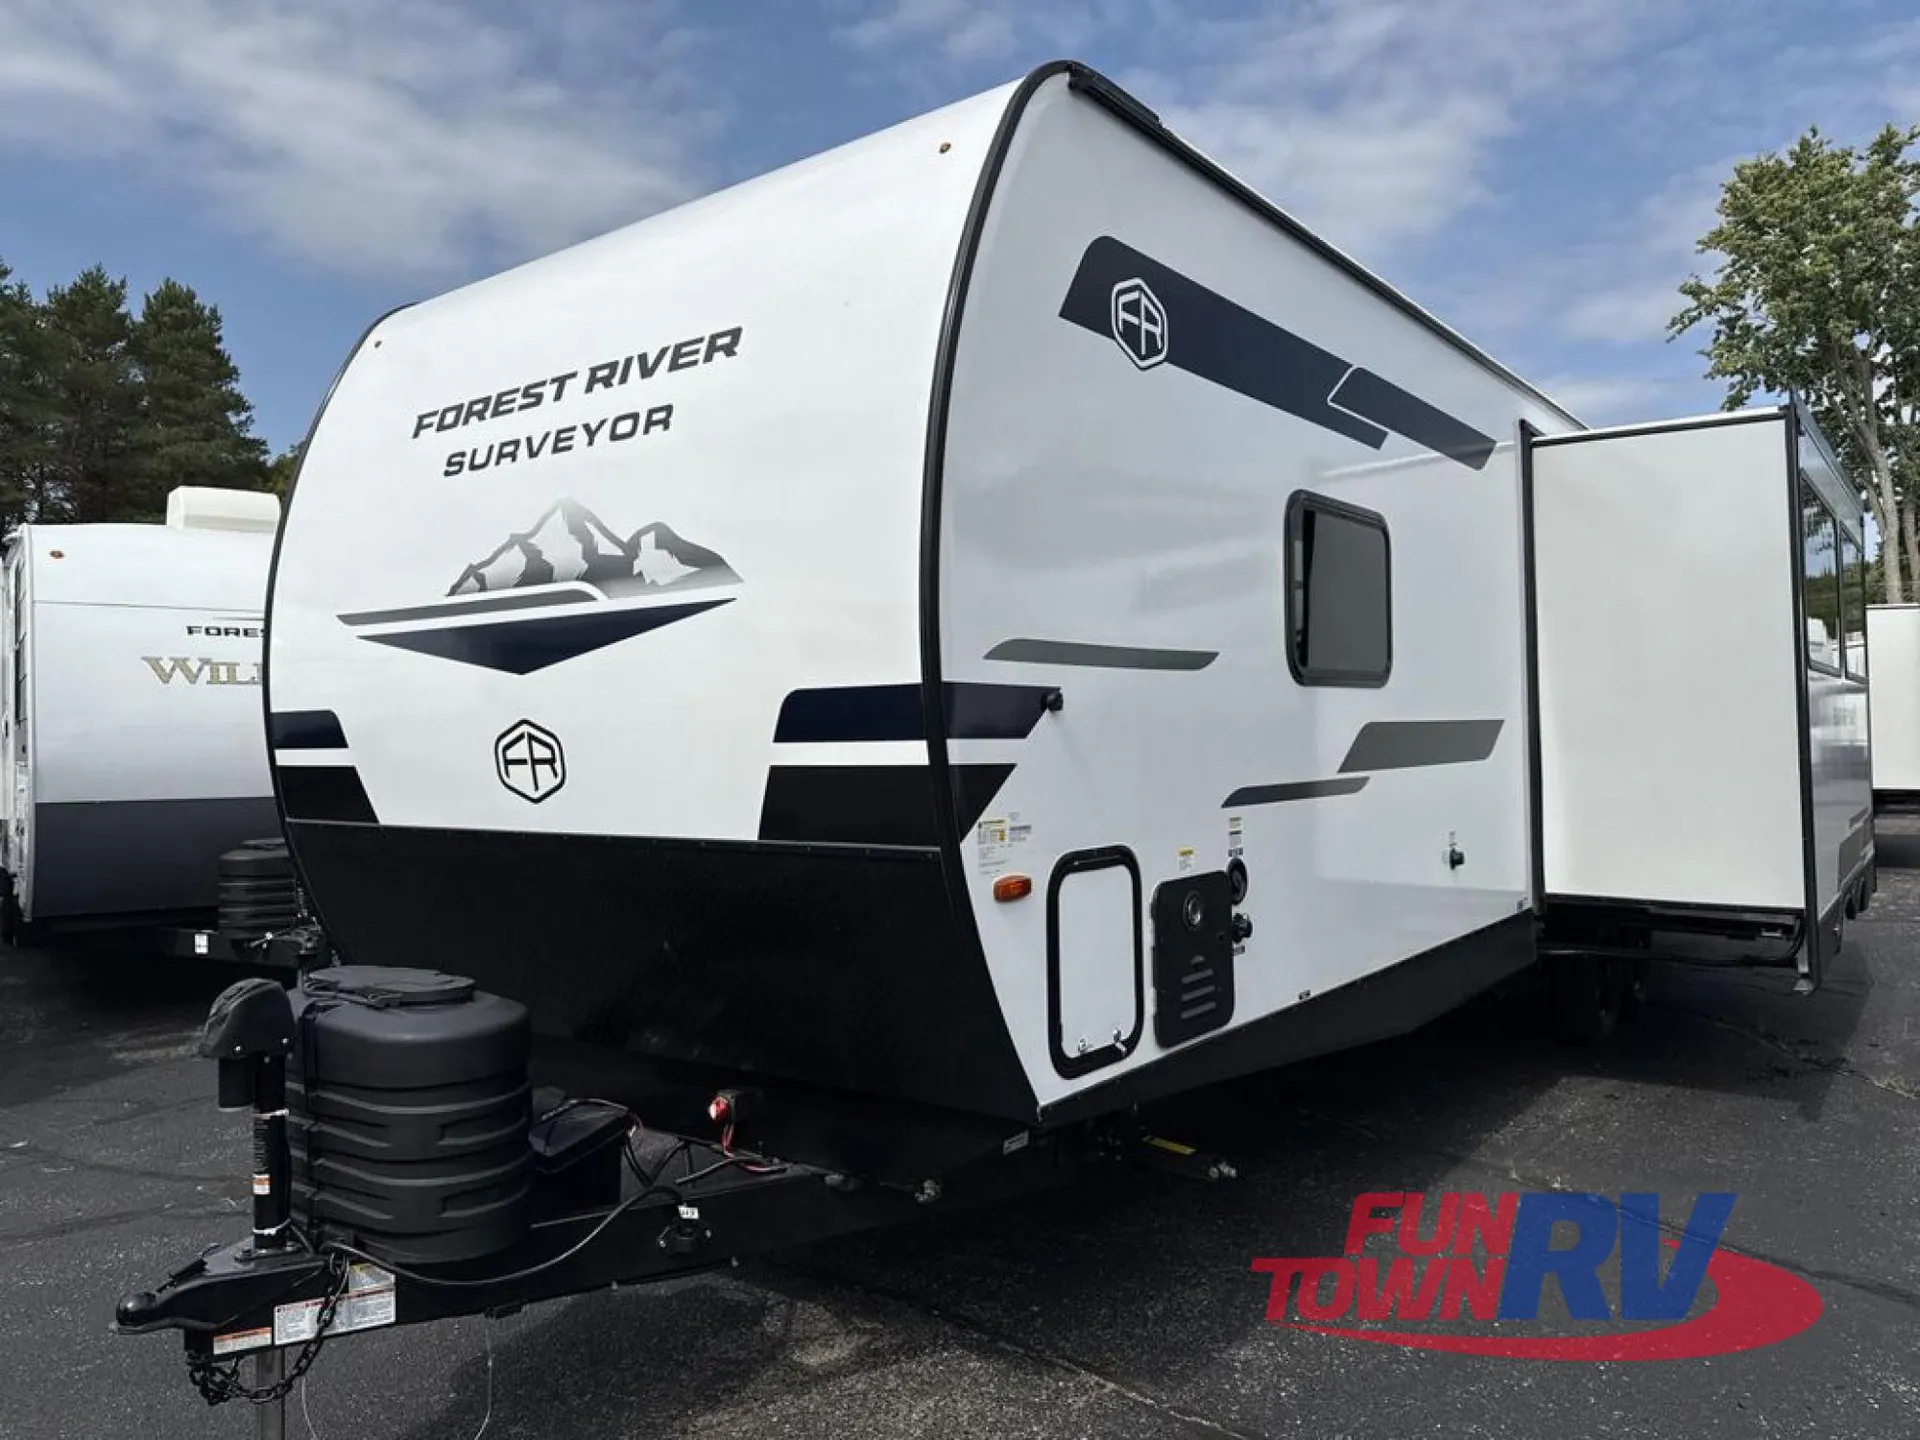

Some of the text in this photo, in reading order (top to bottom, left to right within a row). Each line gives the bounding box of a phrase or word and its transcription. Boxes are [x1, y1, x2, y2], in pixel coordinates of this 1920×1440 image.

[411, 326, 743, 439] FOREST RIVER
[443, 404, 674, 477] SURVEYOR
